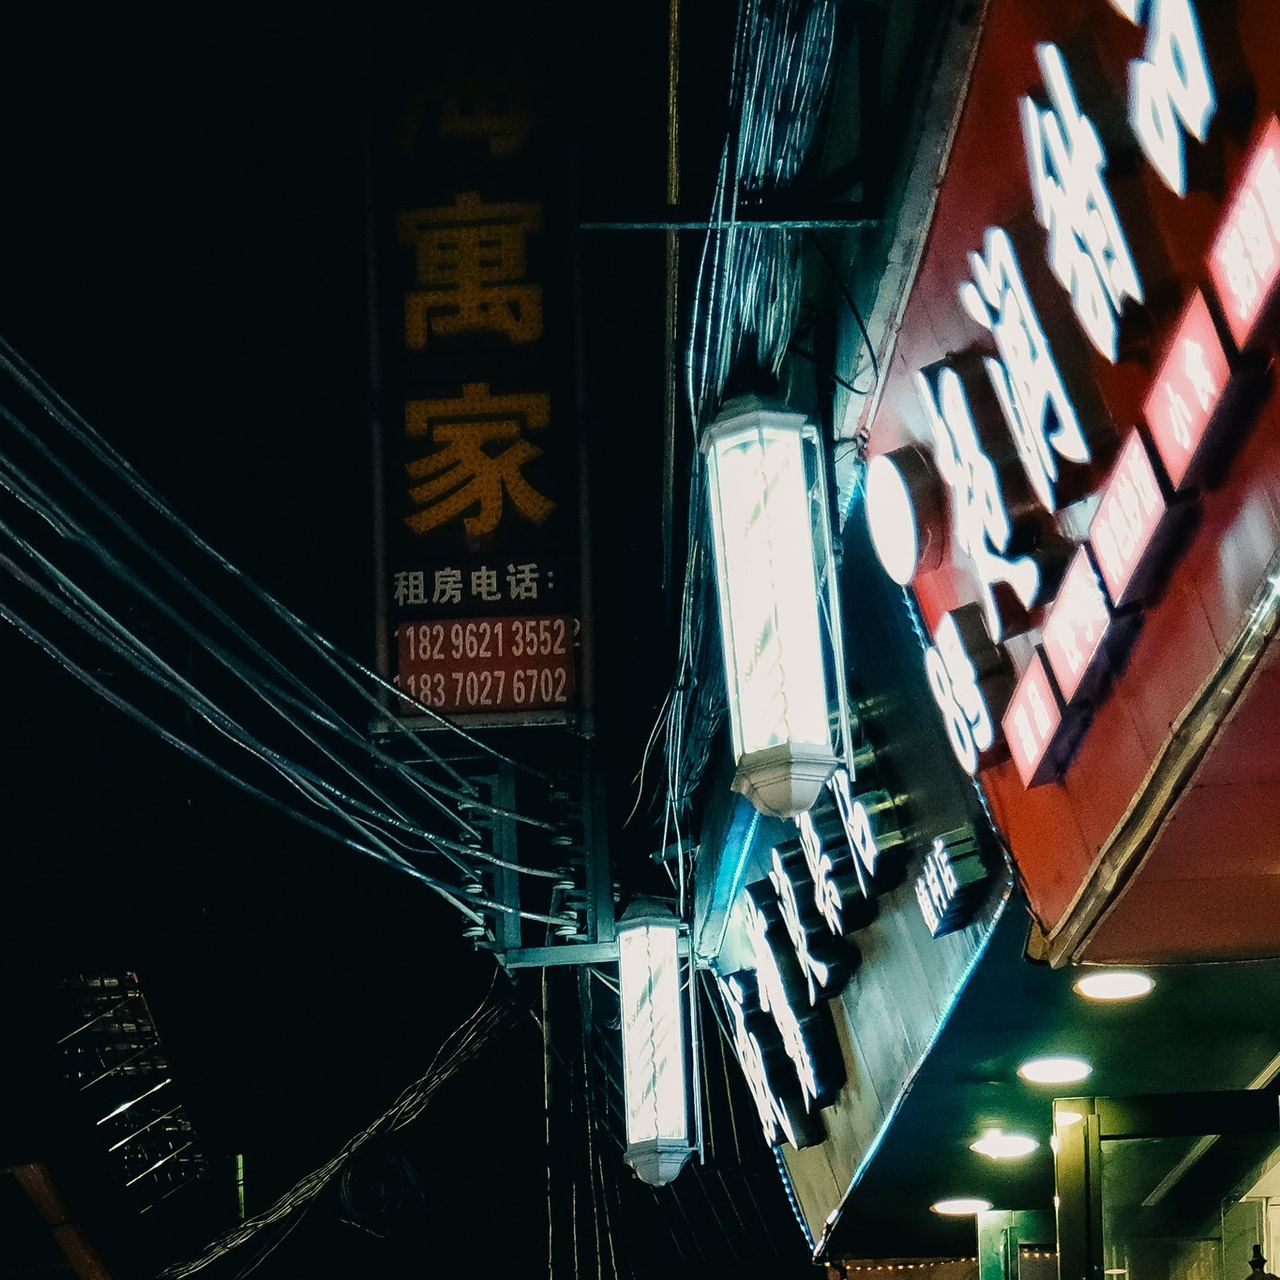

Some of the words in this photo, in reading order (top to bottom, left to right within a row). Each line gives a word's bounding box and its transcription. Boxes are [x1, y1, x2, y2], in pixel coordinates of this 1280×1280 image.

[406, 624, 445, 661] 182
[451, 622, 503, 660] 9621
[511, 618, 566, 657] 3552
[407, 672, 446, 707] 183
[451, 670, 506, 706] 7027
[512, 667, 567, 704] 6702
